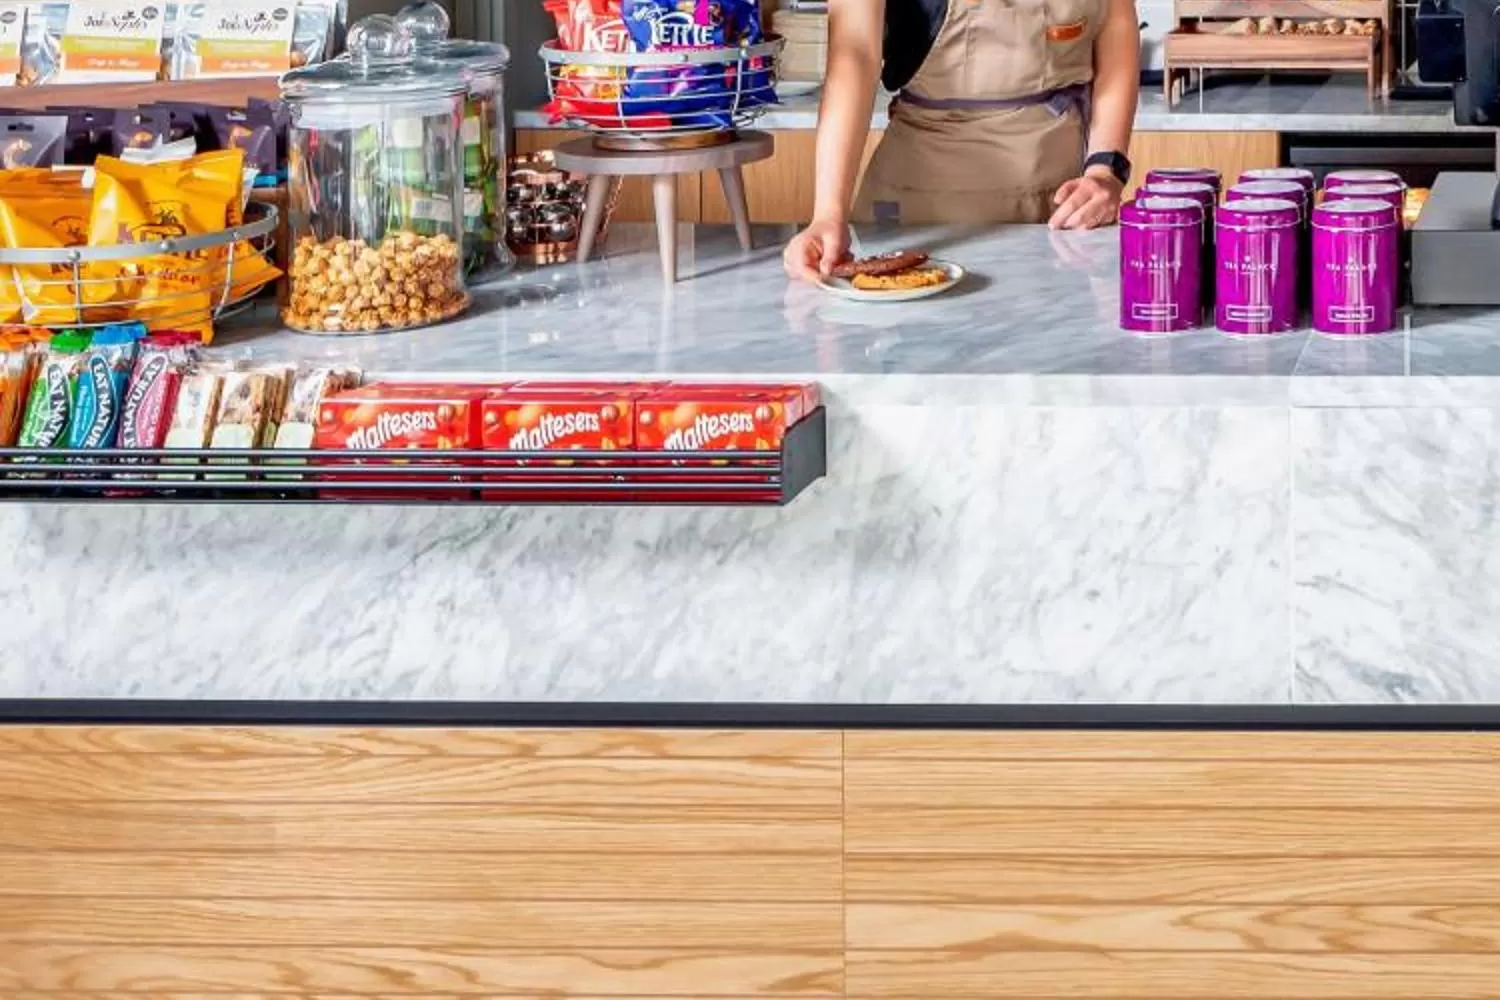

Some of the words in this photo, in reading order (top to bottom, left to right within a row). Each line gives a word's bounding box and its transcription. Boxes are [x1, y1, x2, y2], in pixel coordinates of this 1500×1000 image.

[92, 362, 110, 389] EAT
[346, 410, 438, 450] Maltesers
[509, 410, 600, 450] Maltesers
[664, 410, 754, 450] Maltesers
